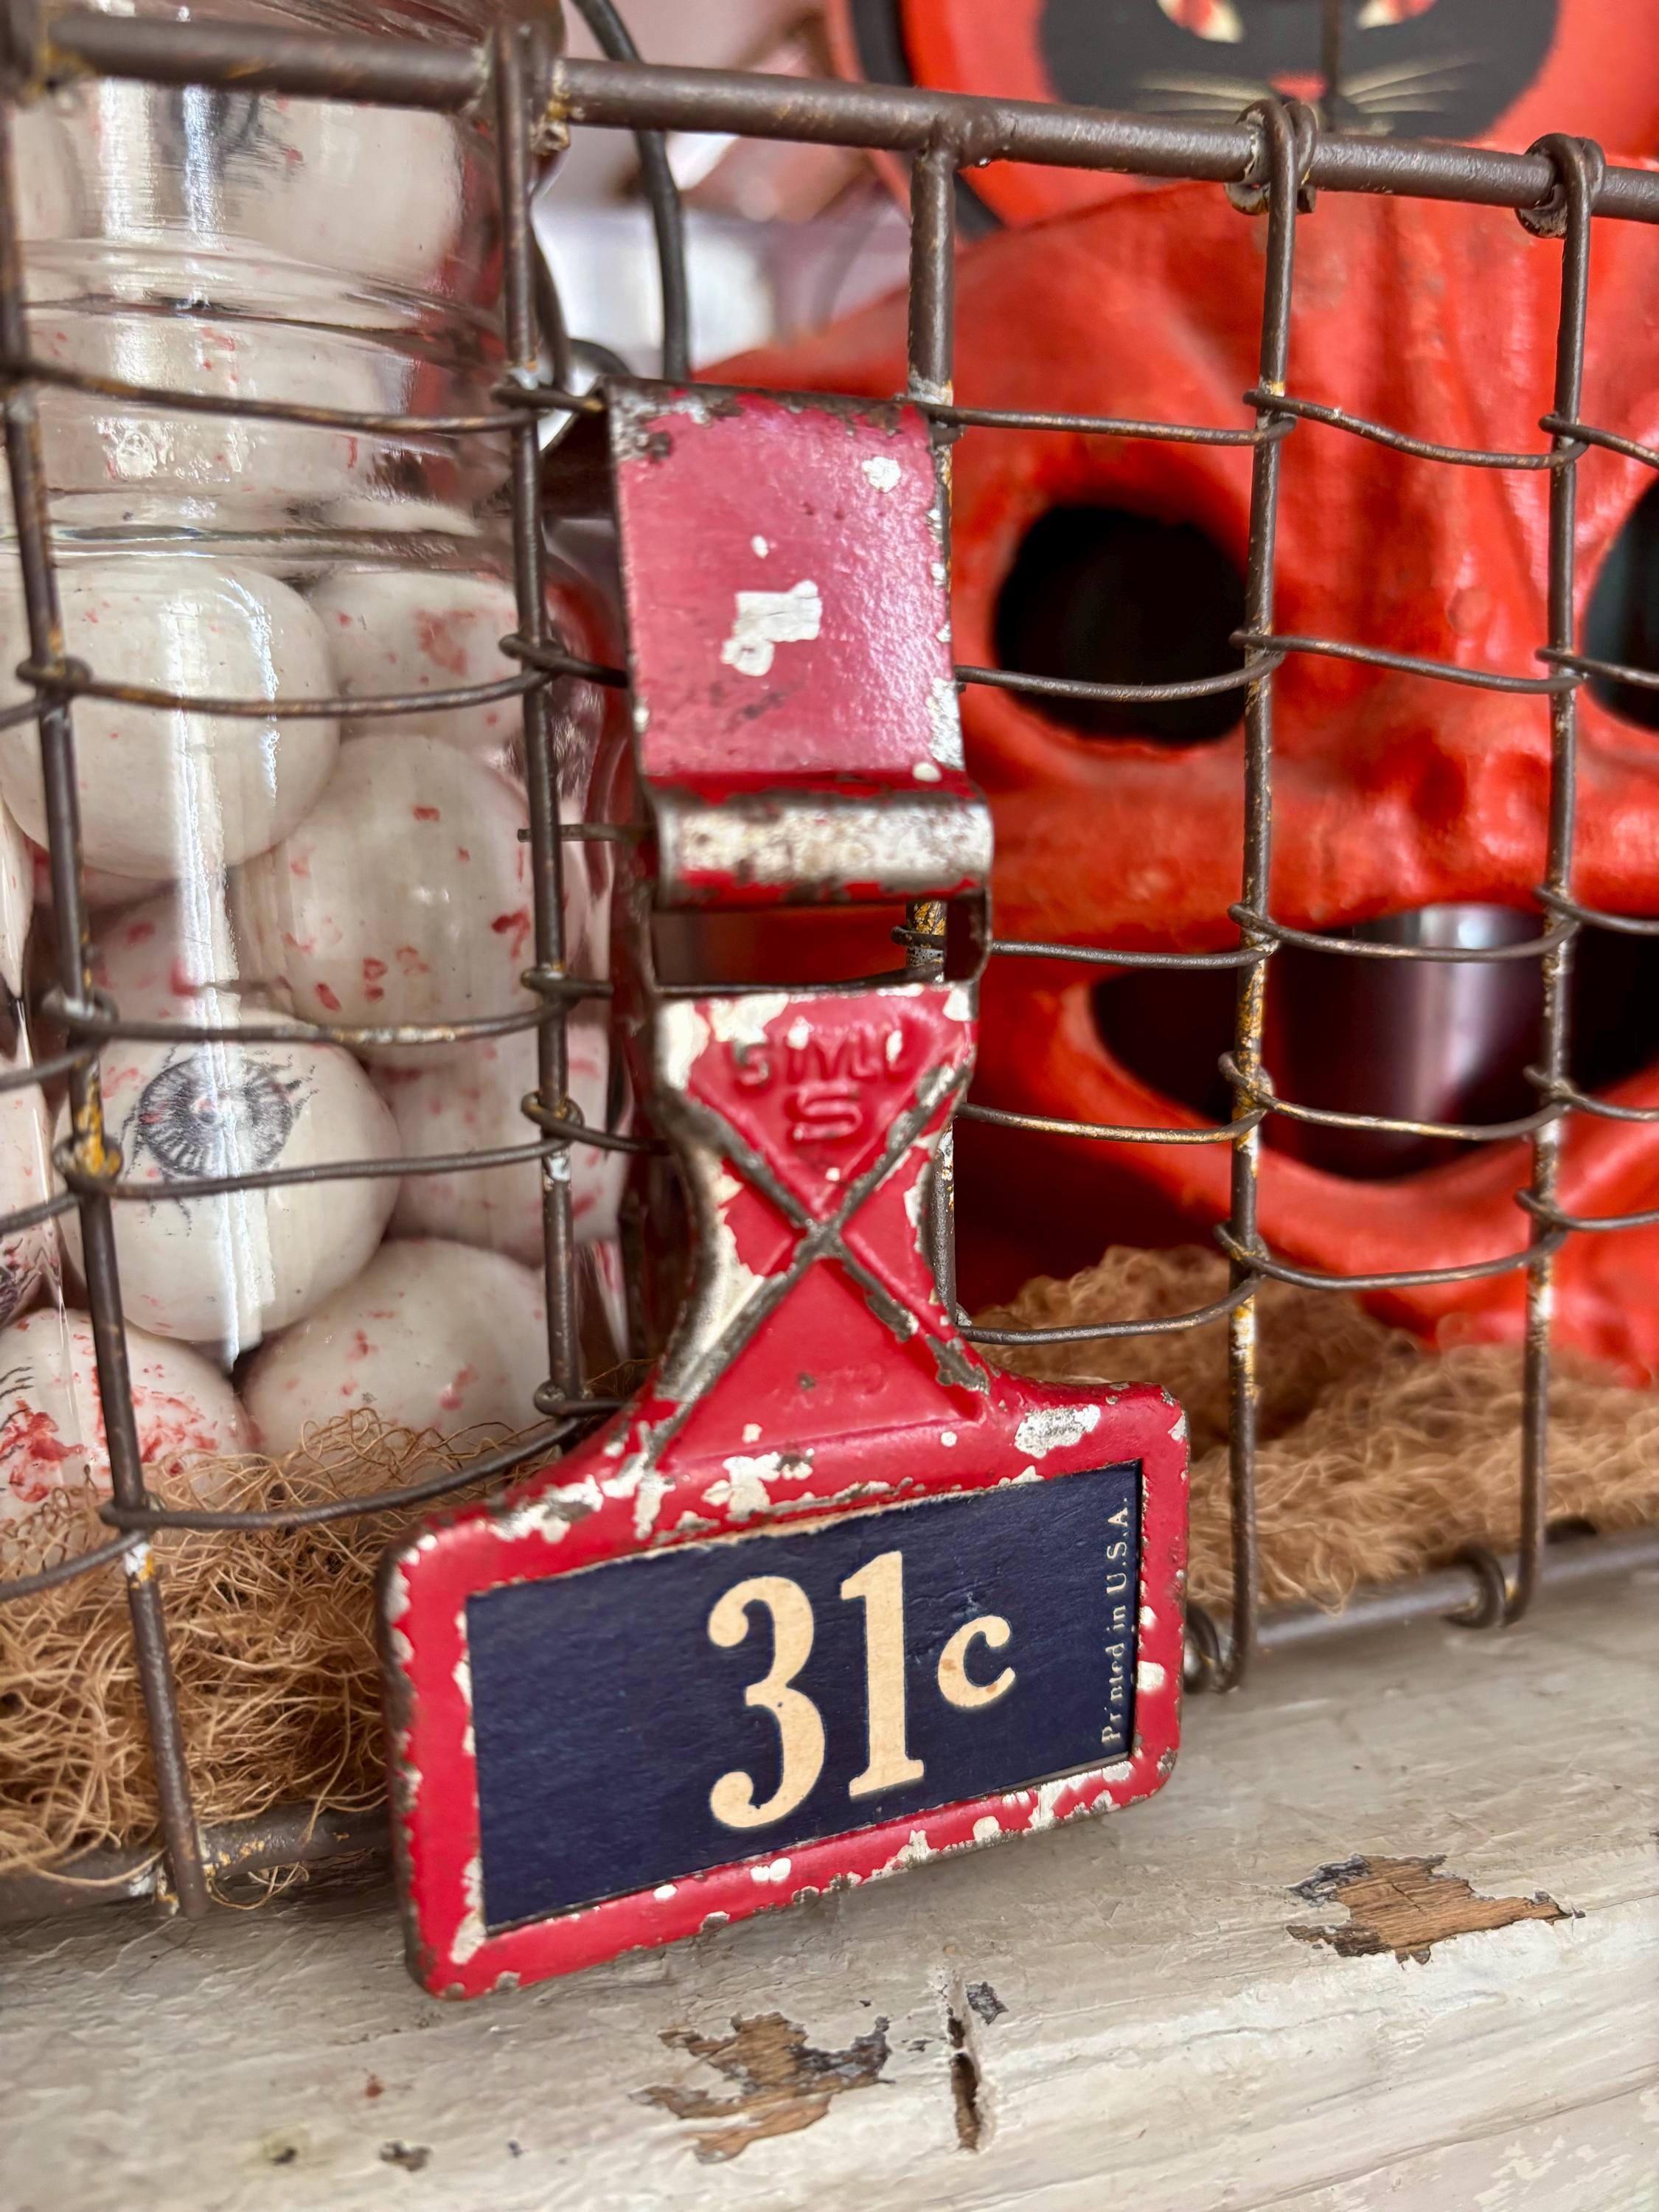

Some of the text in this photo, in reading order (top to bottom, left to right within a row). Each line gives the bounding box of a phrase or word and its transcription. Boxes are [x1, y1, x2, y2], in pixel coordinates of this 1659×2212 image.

[1101, 1498, 1130, 1745] Prnted in U.S.A.
